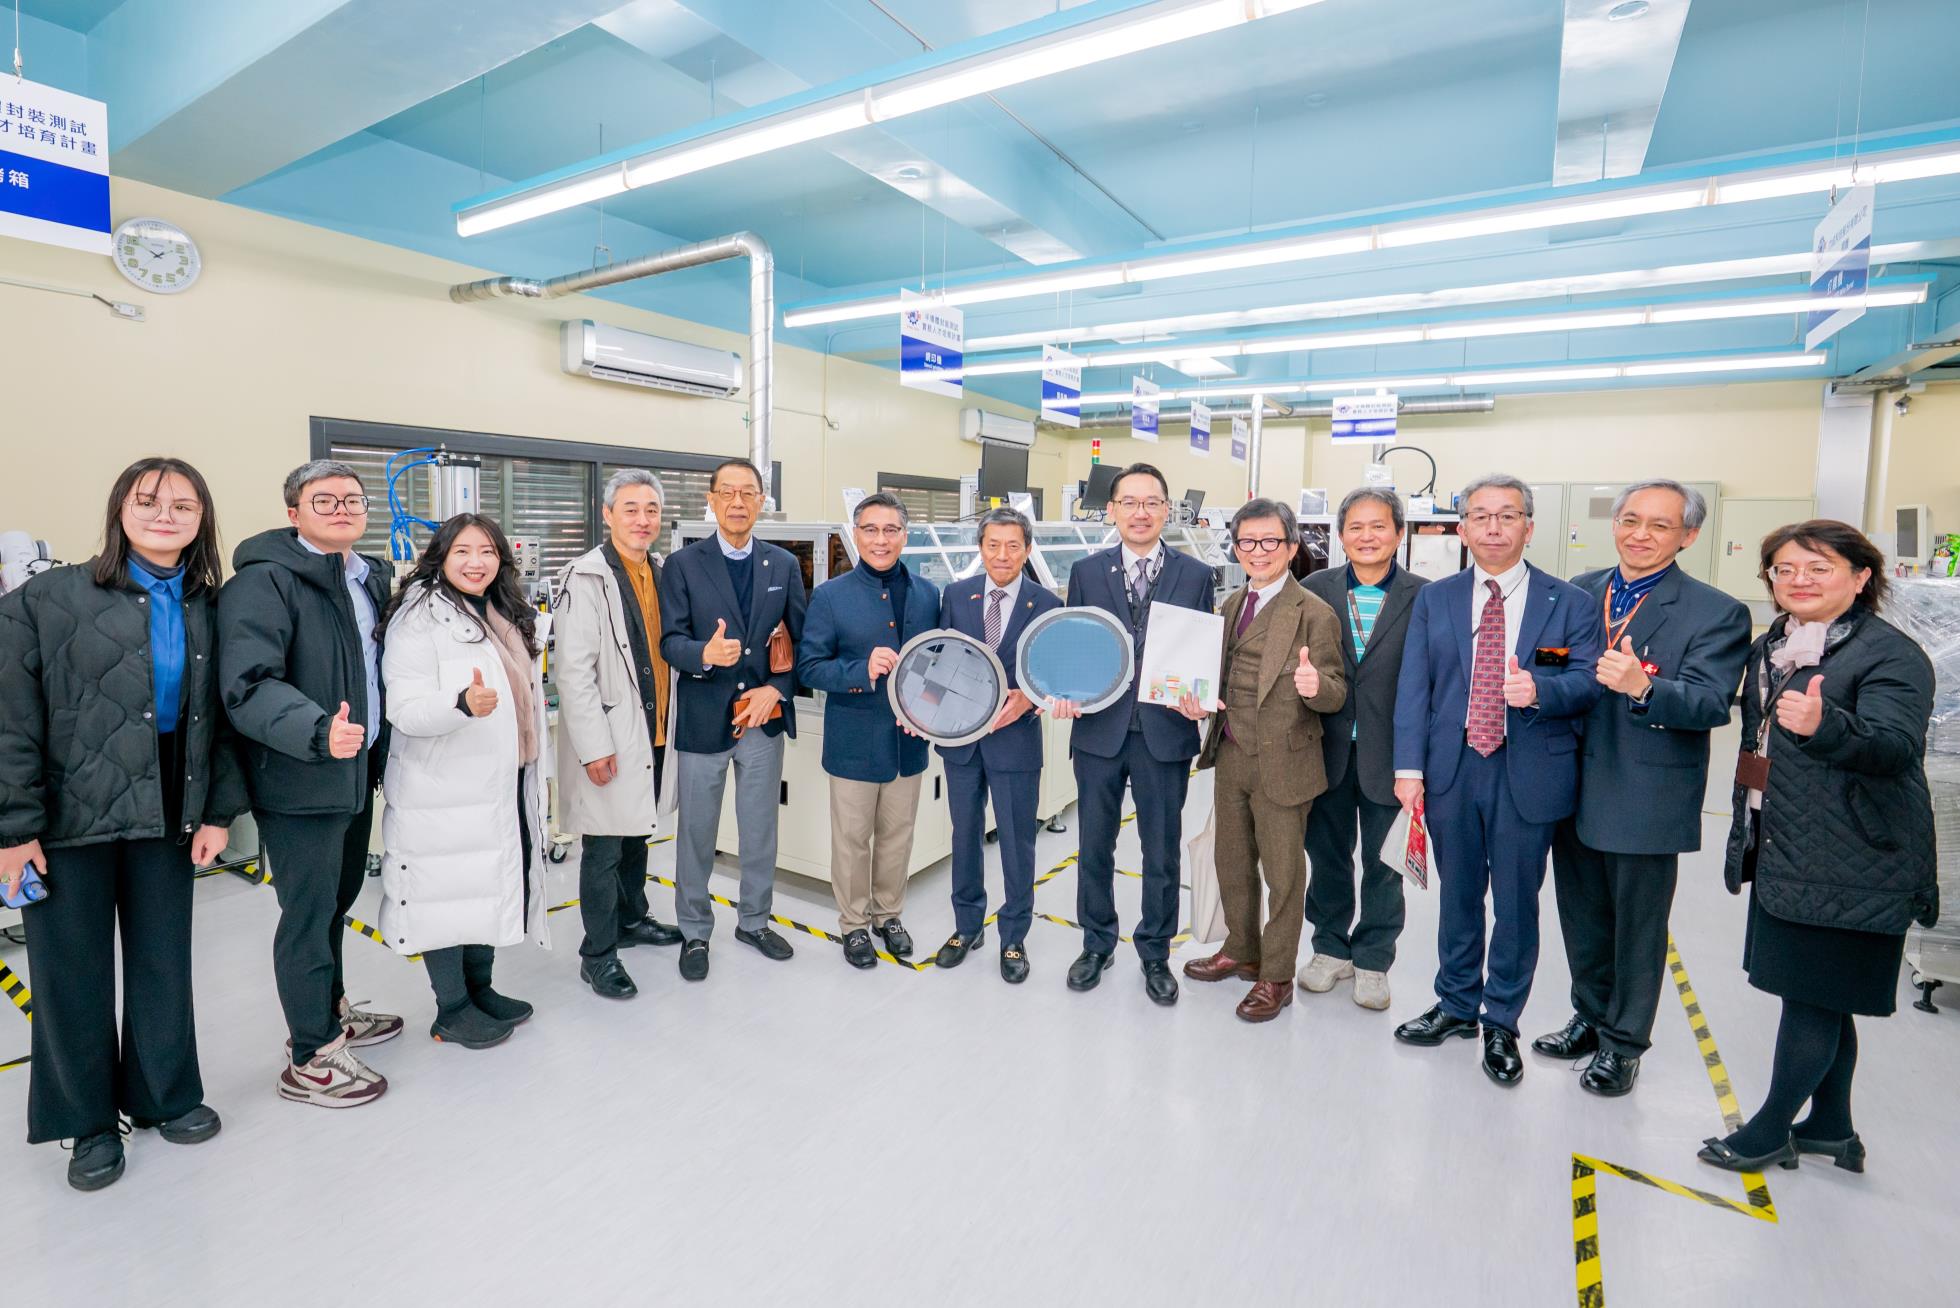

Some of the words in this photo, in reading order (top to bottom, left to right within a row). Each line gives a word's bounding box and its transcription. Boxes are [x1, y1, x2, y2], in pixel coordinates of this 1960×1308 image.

[0, 100, 87, 137] 封裝測試
[0, 119, 97, 156] 才培育計畫
[0, 168, 29, 190] 箱
